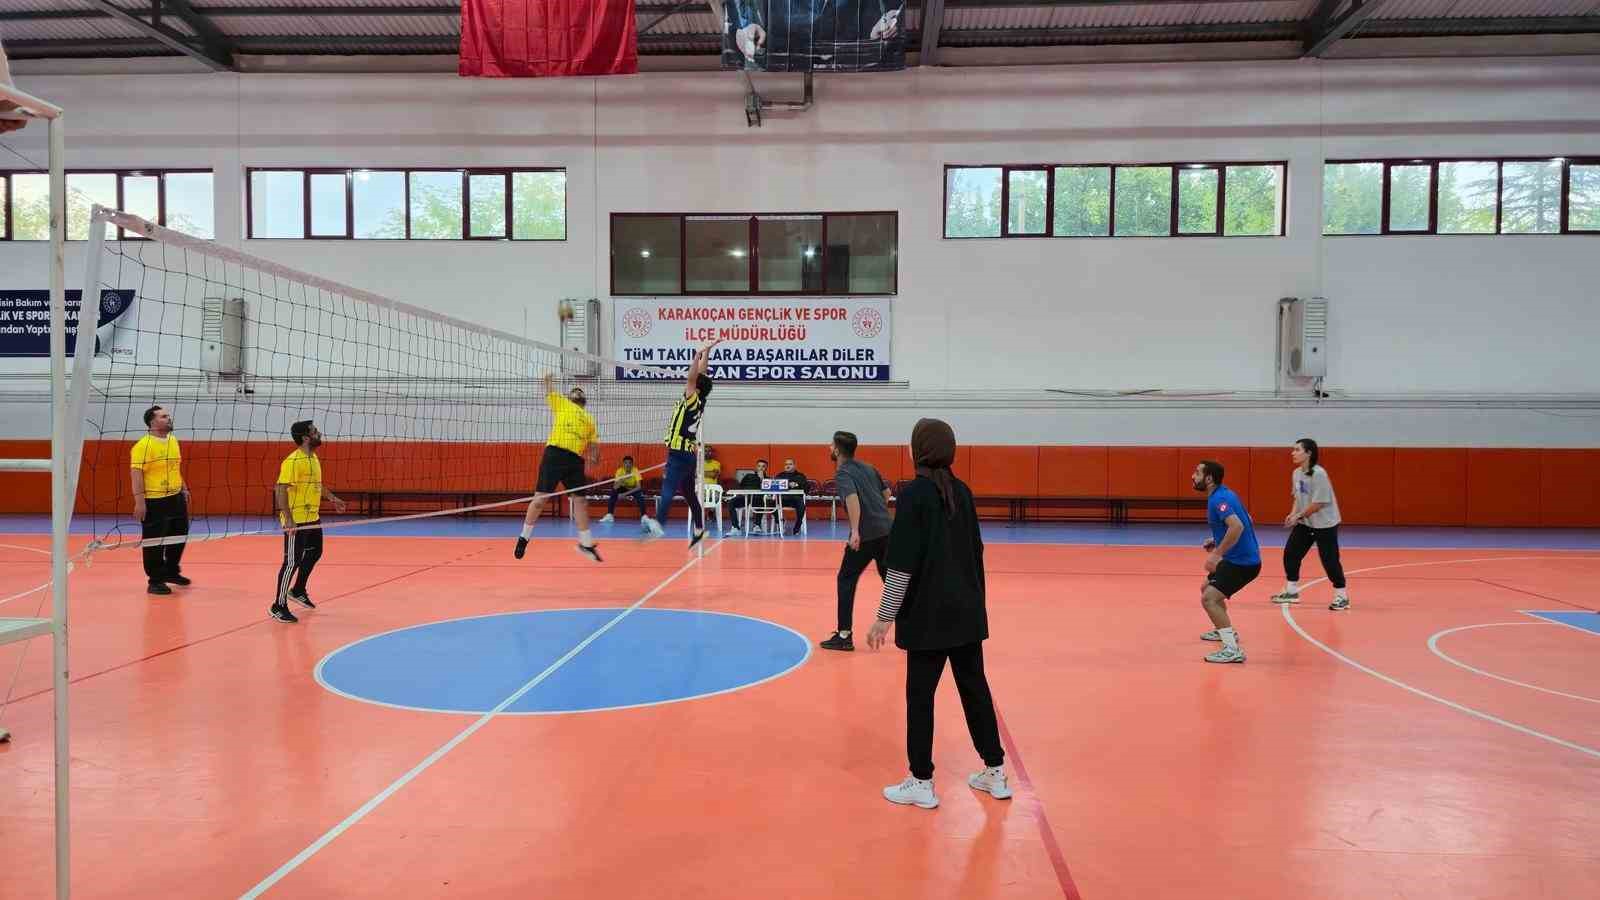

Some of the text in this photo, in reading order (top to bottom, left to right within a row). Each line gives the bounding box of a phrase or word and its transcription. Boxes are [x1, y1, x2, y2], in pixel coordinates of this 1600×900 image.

[12, 311, 24, 320] VE
[26, 311, 50, 320] SPOR
[658, 308, 735, 322] KARAKOÇAN
[795, 308, 811, 320] VE
[814, 308, 847, 320] SPOR
[719, 324, 806, 341] MÜDÜRLÜĞÜ
[746, 349, 828, 362] BAŞARILAR
[745, 366, 796, 379] SPOR
[800, 366, 878, 379] SALONU
